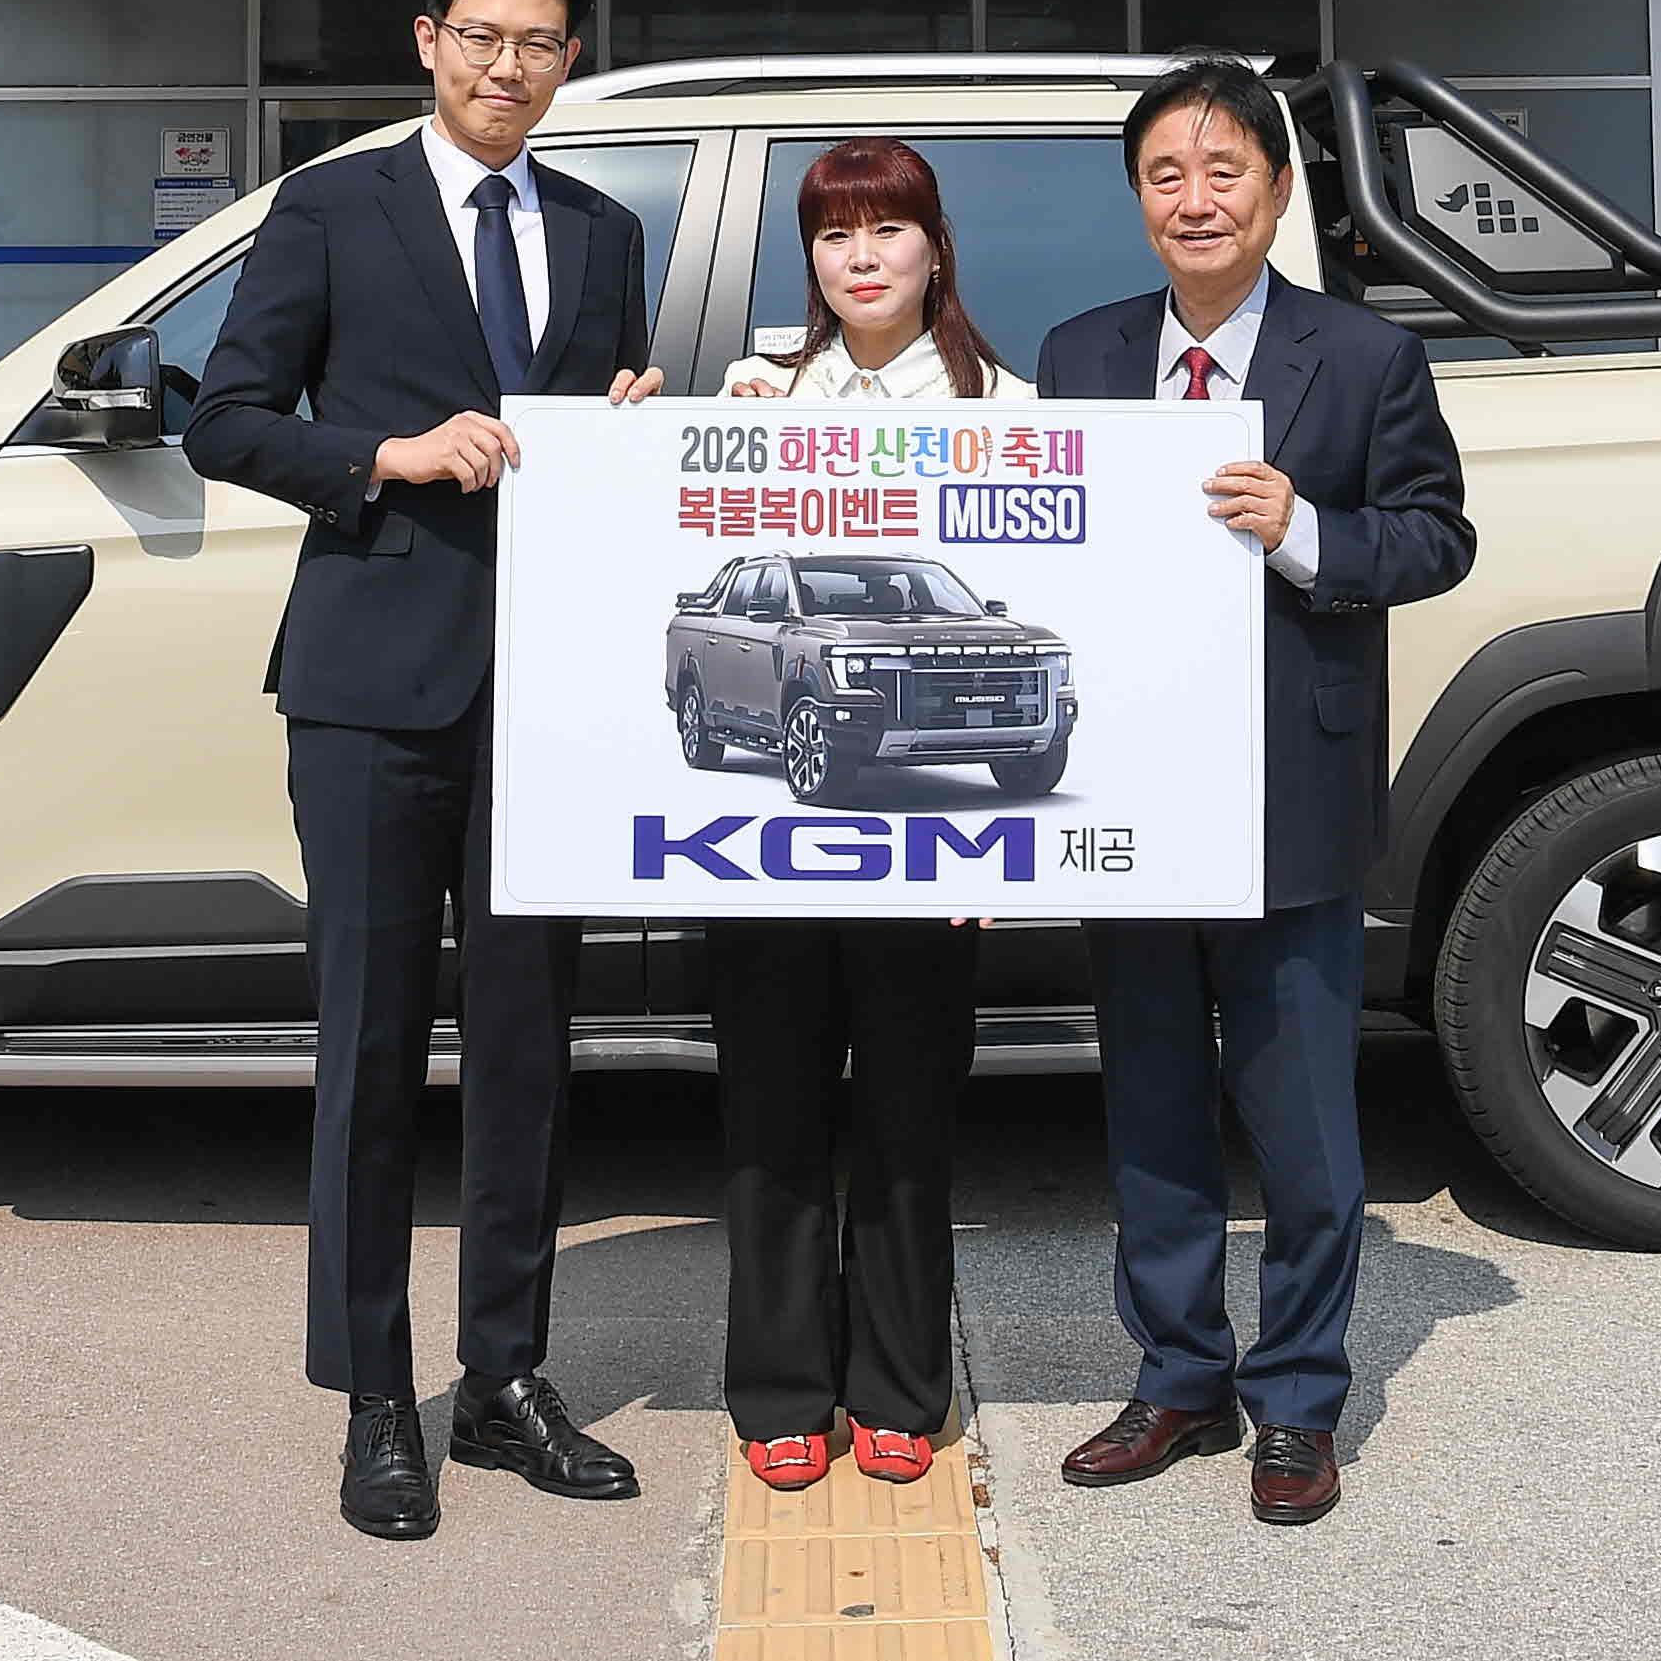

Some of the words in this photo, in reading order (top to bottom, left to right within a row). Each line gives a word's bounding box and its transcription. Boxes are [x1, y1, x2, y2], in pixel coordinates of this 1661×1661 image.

[681, 426, 768, 474] 2026
[778, 426, 861, 477] 화천
[867, 425, 994, 478] 산천어
[1000, 426, 1084, 478] 축제
[678, 486, 919, 538] 복불복이벤트
[945, 487, 1082, 541] MUSSO
[633, 815, 1036, 882] KGM
[1059, 827, 1136, 872] 제공
